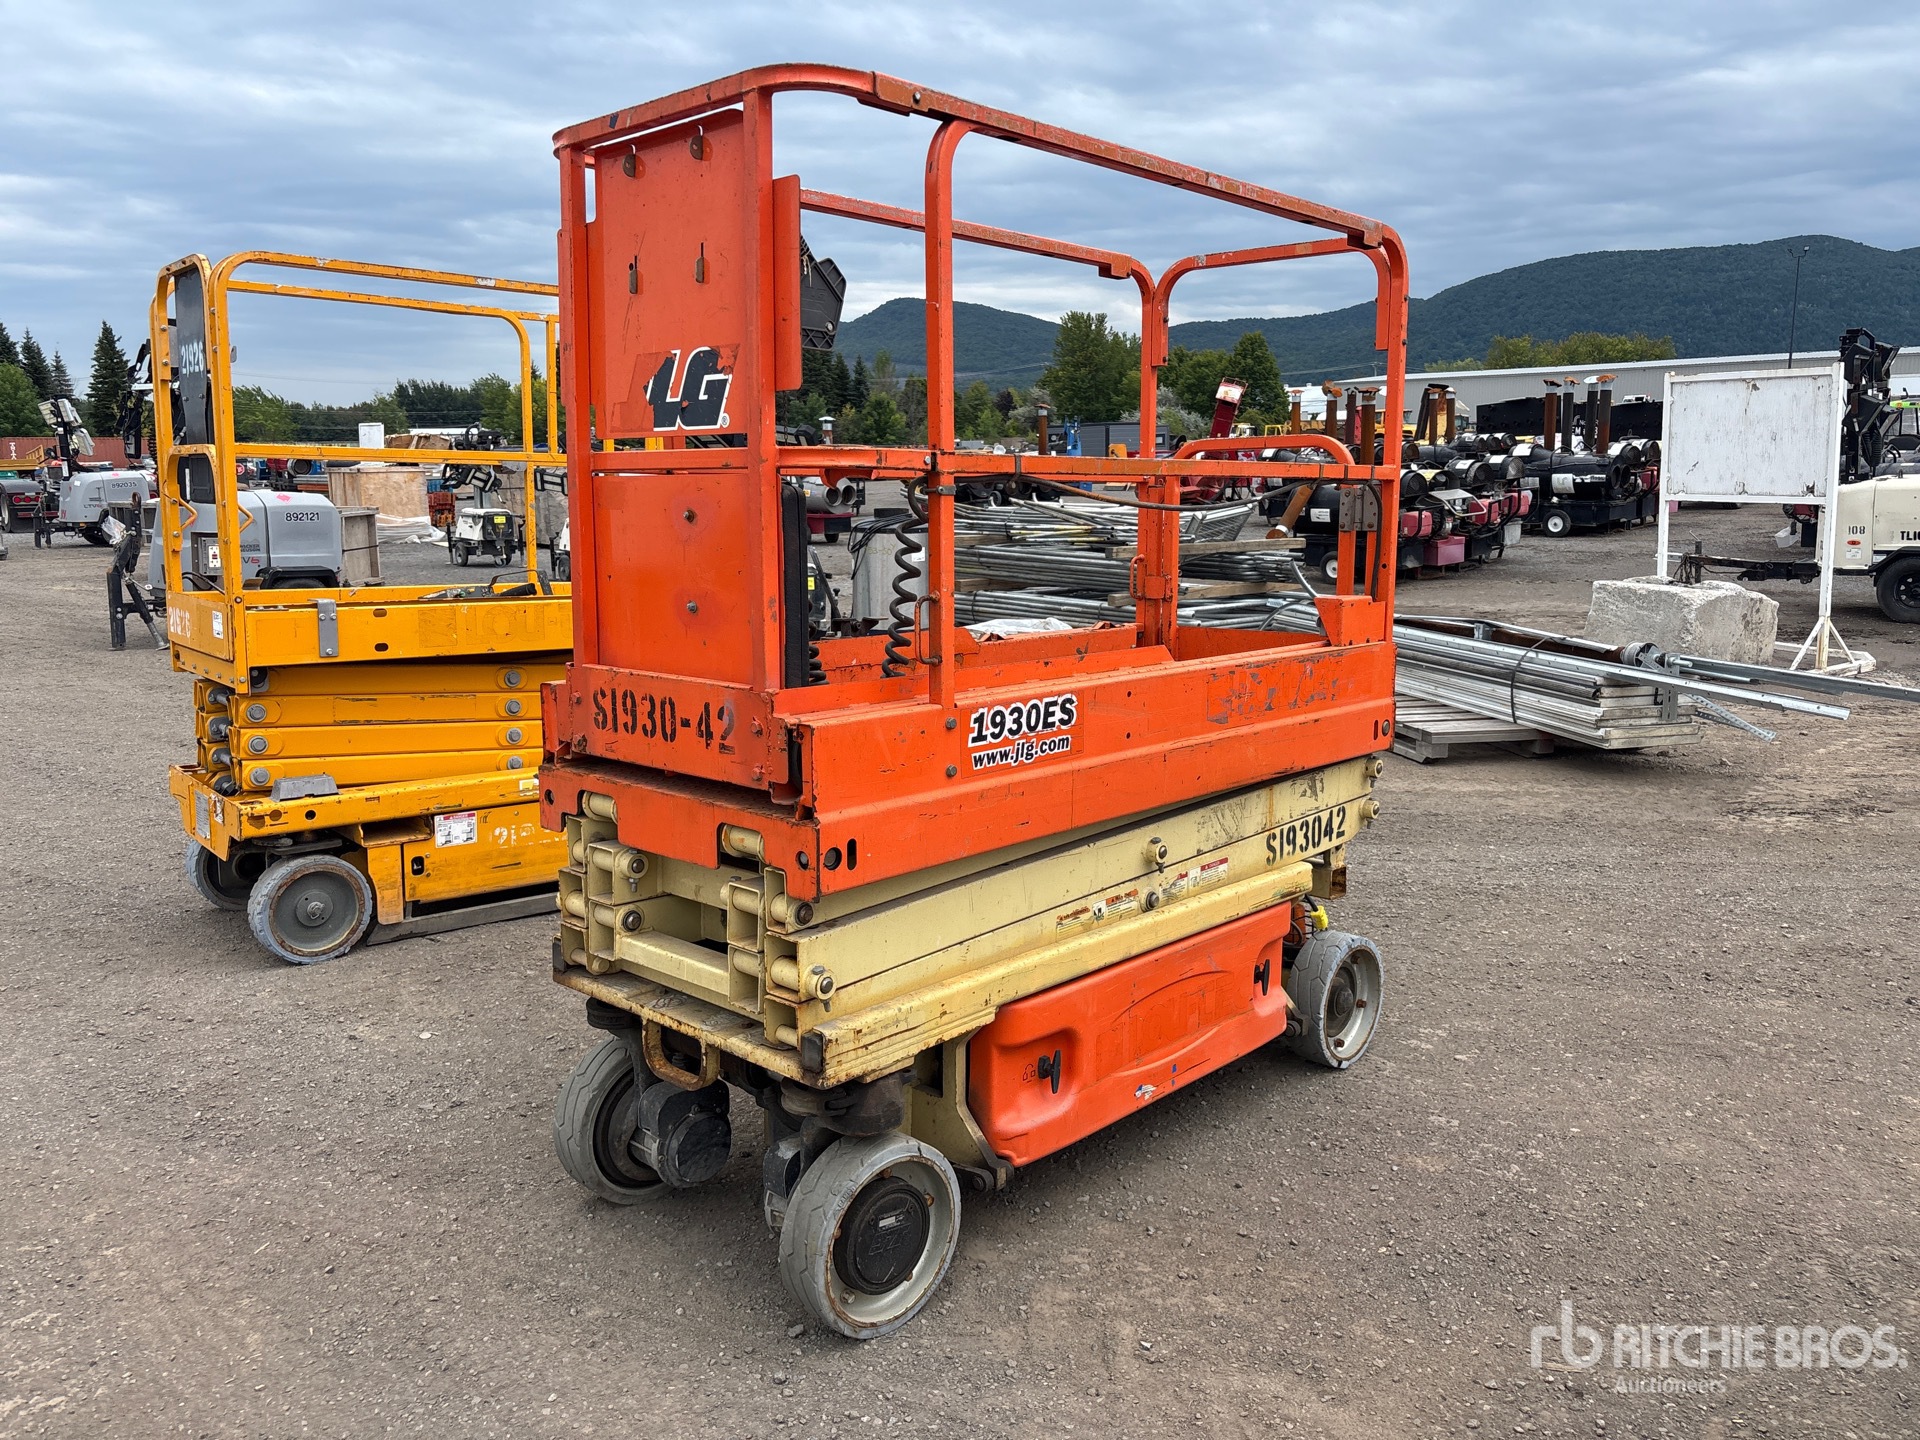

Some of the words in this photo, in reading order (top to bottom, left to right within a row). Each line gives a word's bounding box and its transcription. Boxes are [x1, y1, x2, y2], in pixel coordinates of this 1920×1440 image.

[181, 341, 204, 377] 21926
[285, 512, 320, 522] 892121
[969, 696, 1077, 745] 1930ES
[972, 735, 1071, 769] www.jlg.com
